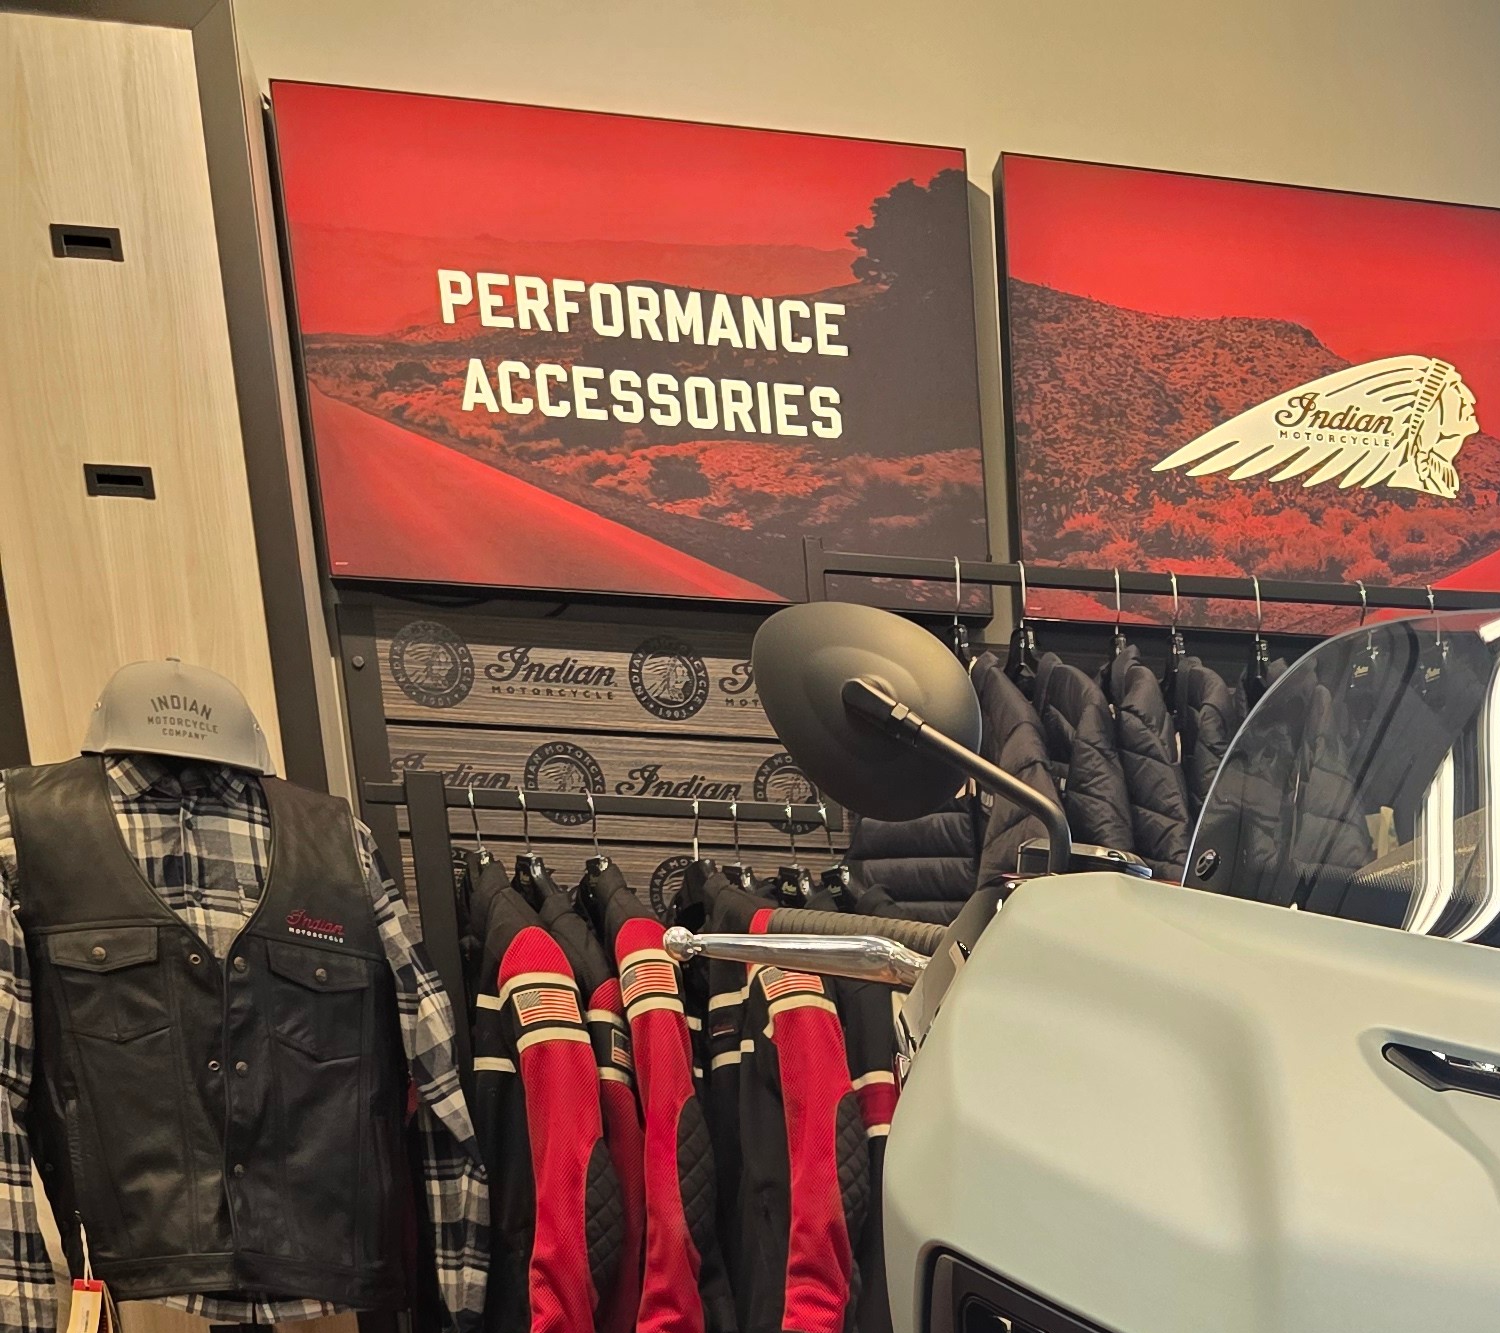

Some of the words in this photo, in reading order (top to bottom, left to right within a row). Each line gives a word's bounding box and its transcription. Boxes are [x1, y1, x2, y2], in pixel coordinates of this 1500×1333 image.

[436, 268, 850, 358] PERFORMANCE
[461, 357, 844, 440] ACCESSORIES
[1274, 391, 1395, 435] Indian
[1279, 430, 1390, 447] MOTORCYCLE
[484, 645, 617, 687] Indian
[491, 685, 615, 700] MOTORCYCLE
[150, 694, 212, 721] INDIAN
[147, 716, 219, 734] MOTORCYCLE
[162, 728, 208, 741] COMPANY
[615, 764, 742, 800] Indian
[286, 909, 345, 936] Indian
[288, 927, 344, 944] MOTORCYCLE
